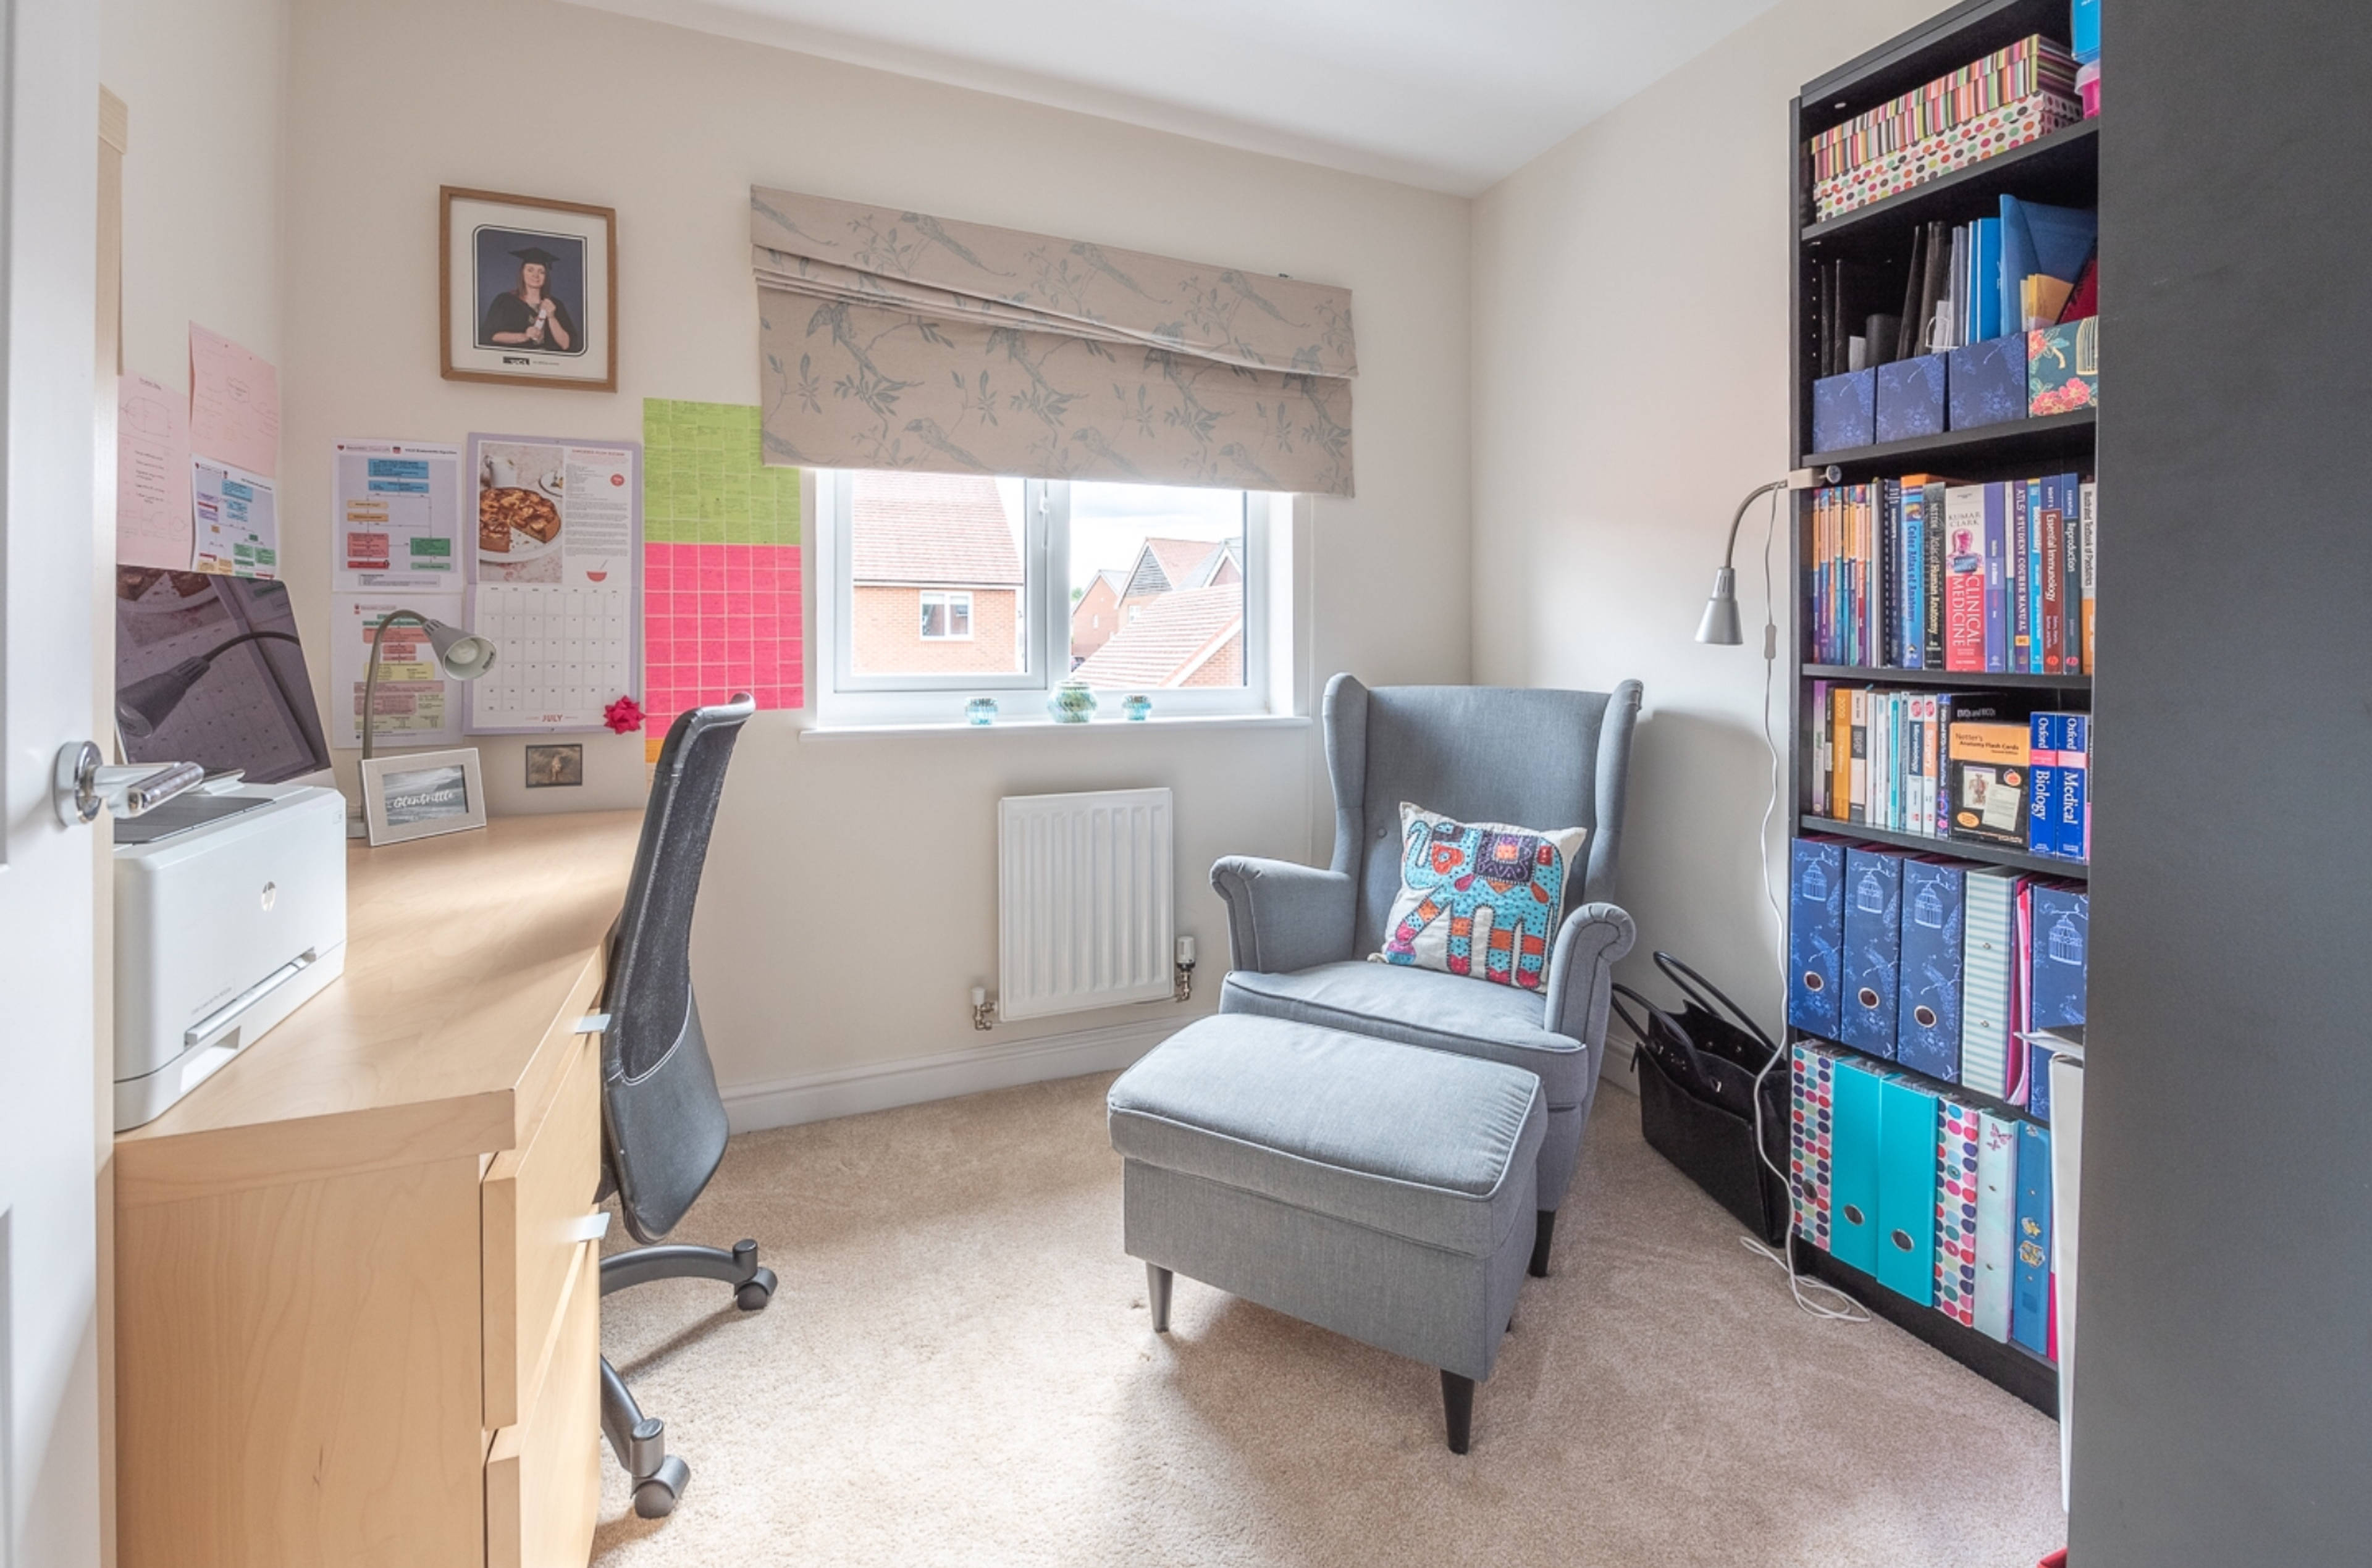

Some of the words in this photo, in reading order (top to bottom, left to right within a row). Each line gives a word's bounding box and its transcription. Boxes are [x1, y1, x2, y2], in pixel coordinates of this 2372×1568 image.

[2017, 516, 2026, 555] STUDENT
[2046, 514, 2057, 548] Essential
[2064, 522, 2077, 572] Reproduction
[1930, 564, 1939, 595] Human
[2017, 558, 2027, 593] COURSE
[2045, 550, 2057, 602] Immunology
[1906, 585, 1916, 622] Anatomy
[1927, 596, 1938, 634] Anatomy
[1952, 577, 1966, 646] MEDICINE
[1966, 576, 1981, 646] CLINICAL
[2018, 595, 2027, 631] MANUAL
[542, 714, 563, 722] JULY
[1837, 696, 1846, 719] 2009
[1911, 724, 1920, 774] Microbiology
[1924, 729, 1934, 769] Surgery
[1960, 740, 1984, 748] Anatomy
[2038, 717, 2048, 748] Oxford
[2066, 717, 2077, 750] Oxford
[393, 789, 455, 808] Glenbrittle
[2031, 769, 2050, 820] Biology
[2063, 771, 2079, 824] Medical
